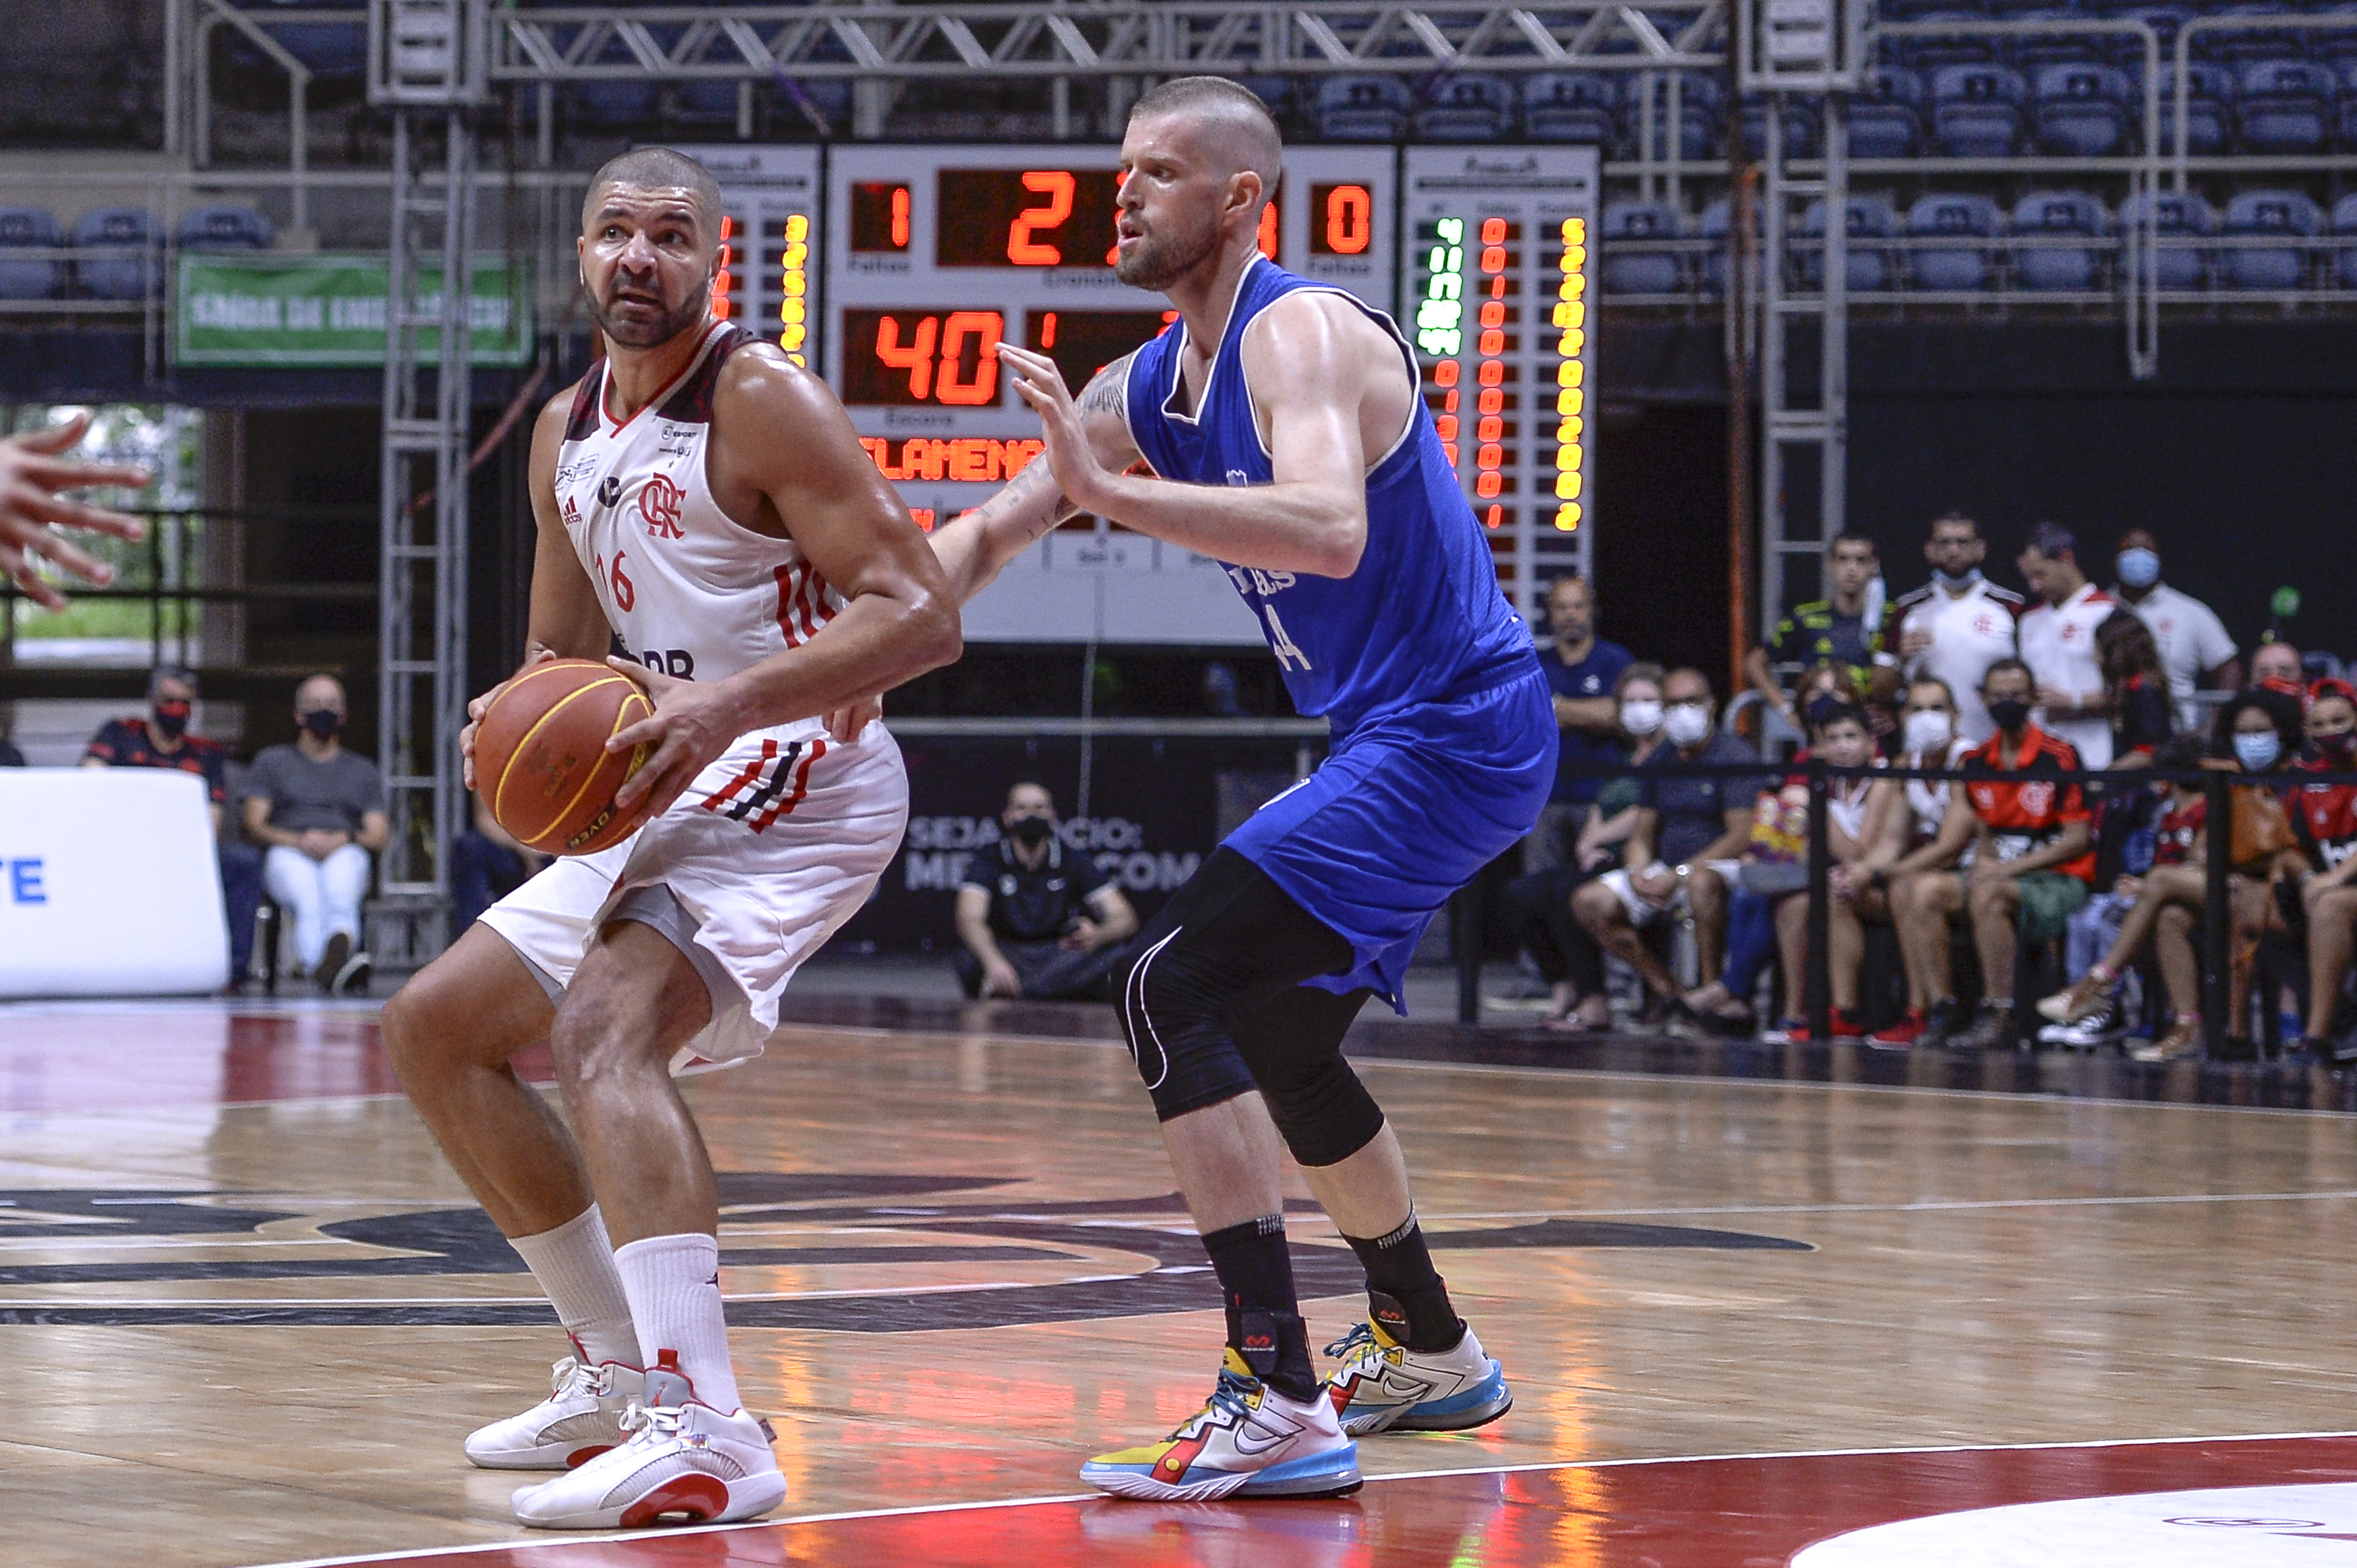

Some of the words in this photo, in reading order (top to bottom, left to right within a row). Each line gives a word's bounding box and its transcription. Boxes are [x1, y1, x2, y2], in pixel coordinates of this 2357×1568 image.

[892, 189, 909, 247] 1
[1328, 185, 1370, 254] 0
[1482, 218, 1507, 246] 0
[1562, 218, 1585, 246] 5
[1430, 246, 1463, 272] 11
[1481, 246, 1506, 274] 0
[1560, 246, 1586, 273] 2
[1492, 275, 1505, 300] 1
[1559, 273, 1585, 301] 2
[1480, 301, 1505, 328] 0
[1479, 329, 1504, 357] 0
[1558, 328, 1584, 357] 2
[876, 312, 1003, 405] 40
[1435, 360, 1460, 388] 0
[1479, 360, 1504, 387] 0
[1558, 360, 1583, 388] 0
[1446, 388, 1458, 413] 1
[1478, 388, 1503, 416] 0
[1557, 388, 1583, 416] 0
[1478, 416, 1503, 443] 0
[1478, 443, 1502, 470] 0
[1556, 444, 1582, 471] 0
[1477, 471, 1502, 498] 0
[1555, 471, 1581, 499] 0
[1488, 504, 1502, 529] 1
[1555, 502, 1581, 531] 2
[596, 550, 635, 613] 16
[1265, 604, 1312, 672] 4
[0, 858, 45, 903] E
